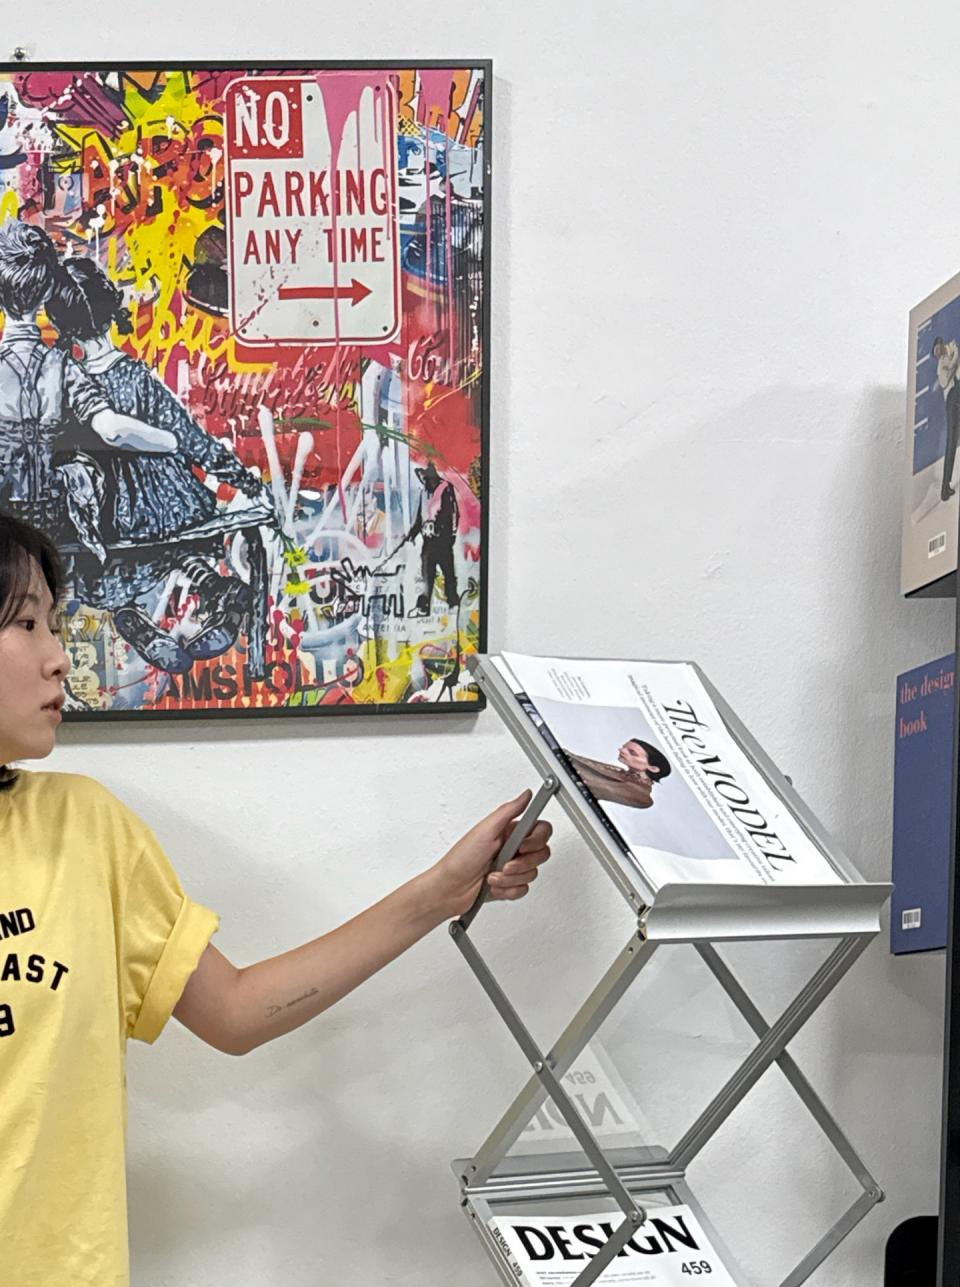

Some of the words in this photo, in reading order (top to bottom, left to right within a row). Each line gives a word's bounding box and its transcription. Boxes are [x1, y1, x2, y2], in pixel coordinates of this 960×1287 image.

[235, 90, 289, 149] NO
[234, 169, 388, 217] PARKING
[243, 229, 302, 264] ANY
[323, 227, 385, 263] TIME
[901, 682, 918, 704] the
[899, 711, 927, 738] book
[690, 748, 798, 871] MODEL
[512, 1215, 701, 1261] DESIGN
[681, 1260, 713, 1277] 459
